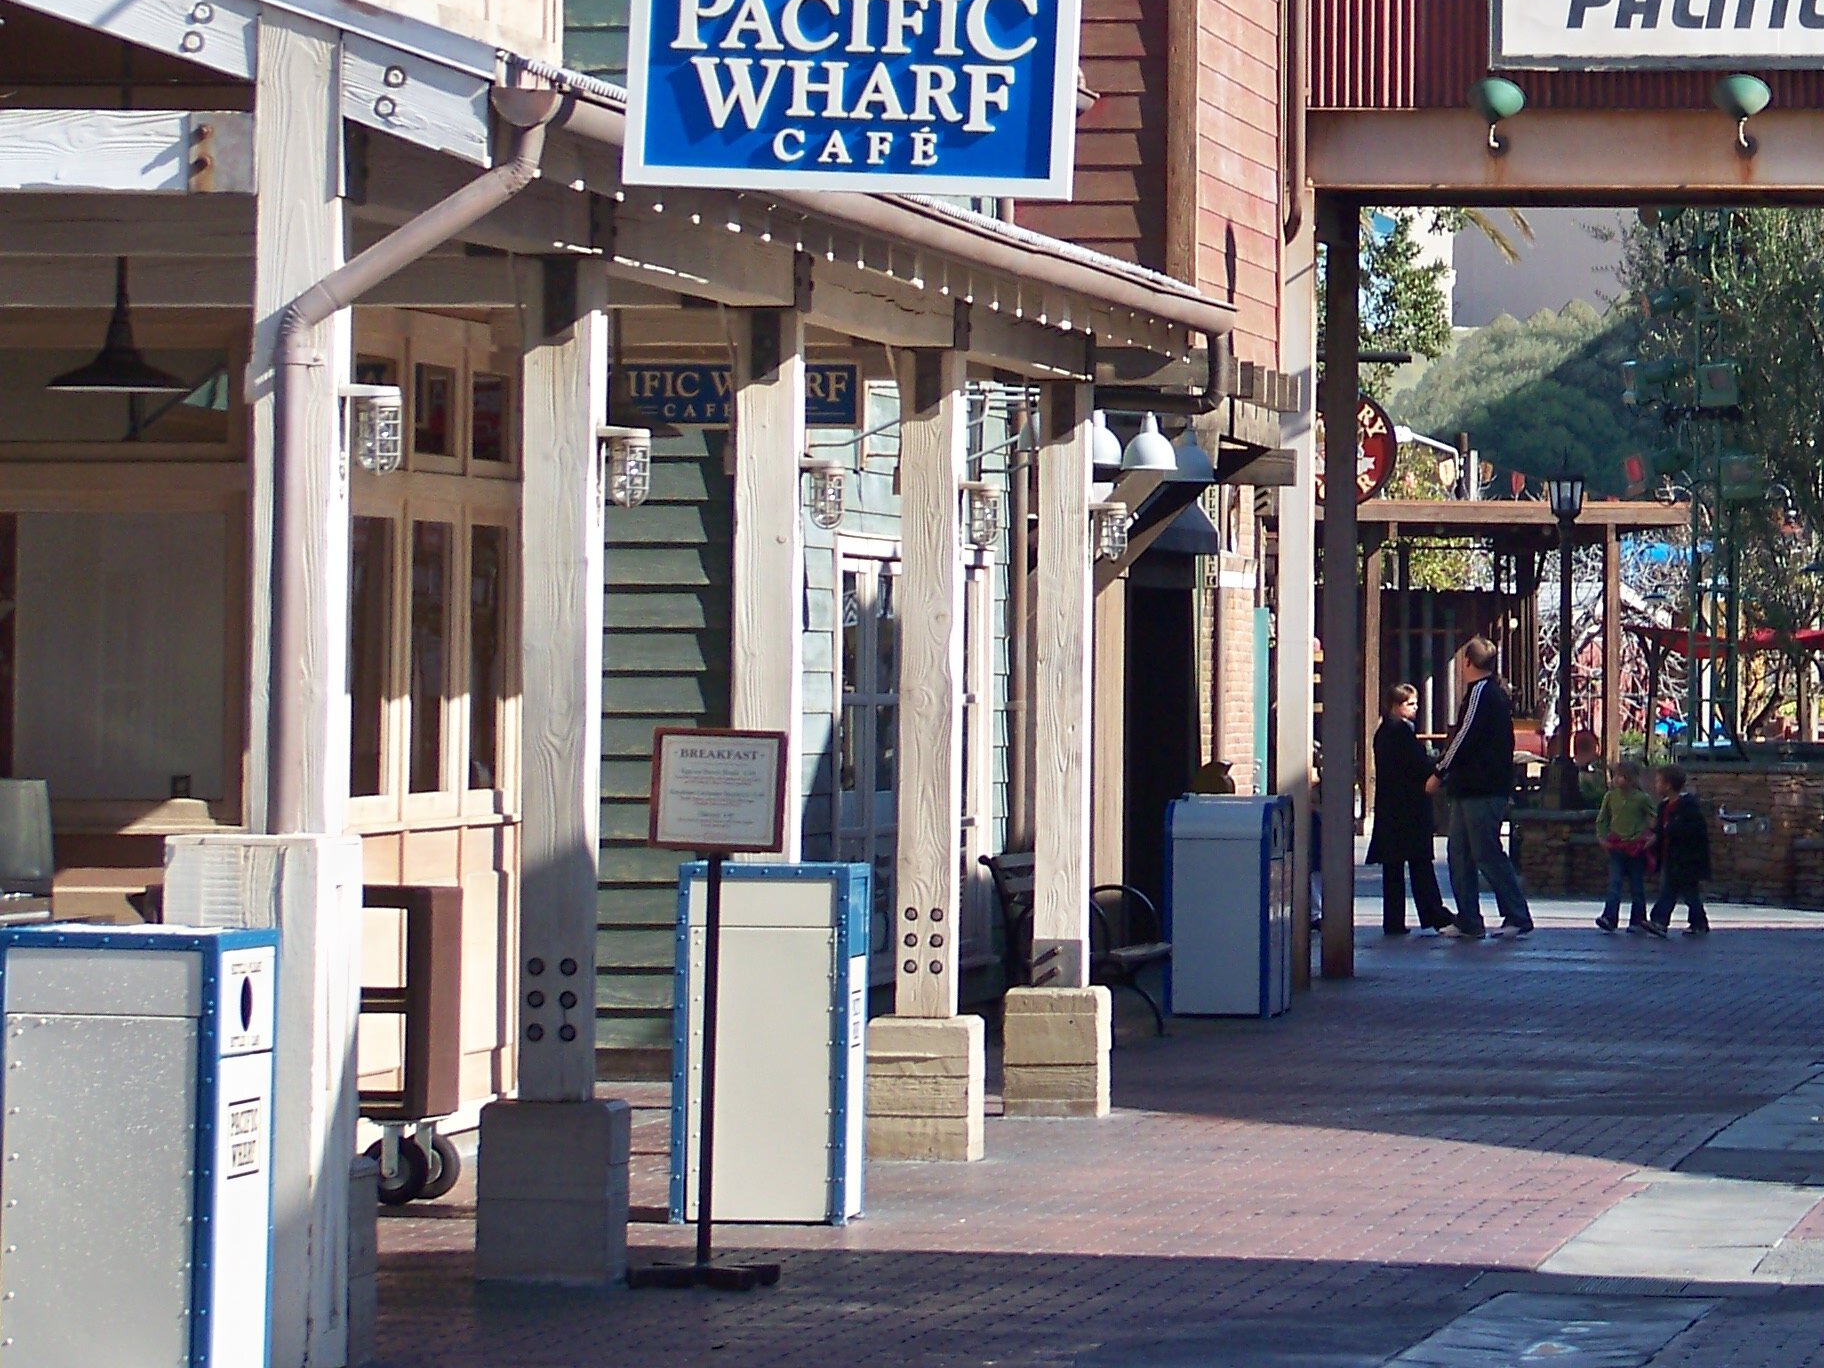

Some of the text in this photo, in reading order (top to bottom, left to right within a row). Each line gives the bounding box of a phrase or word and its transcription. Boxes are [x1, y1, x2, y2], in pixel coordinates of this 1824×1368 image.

[690, 56, 1015, 133] WHARF
[772, 126, 938, 166] CAFÉ
[680, 748, 757, 760] BREAKFAST
